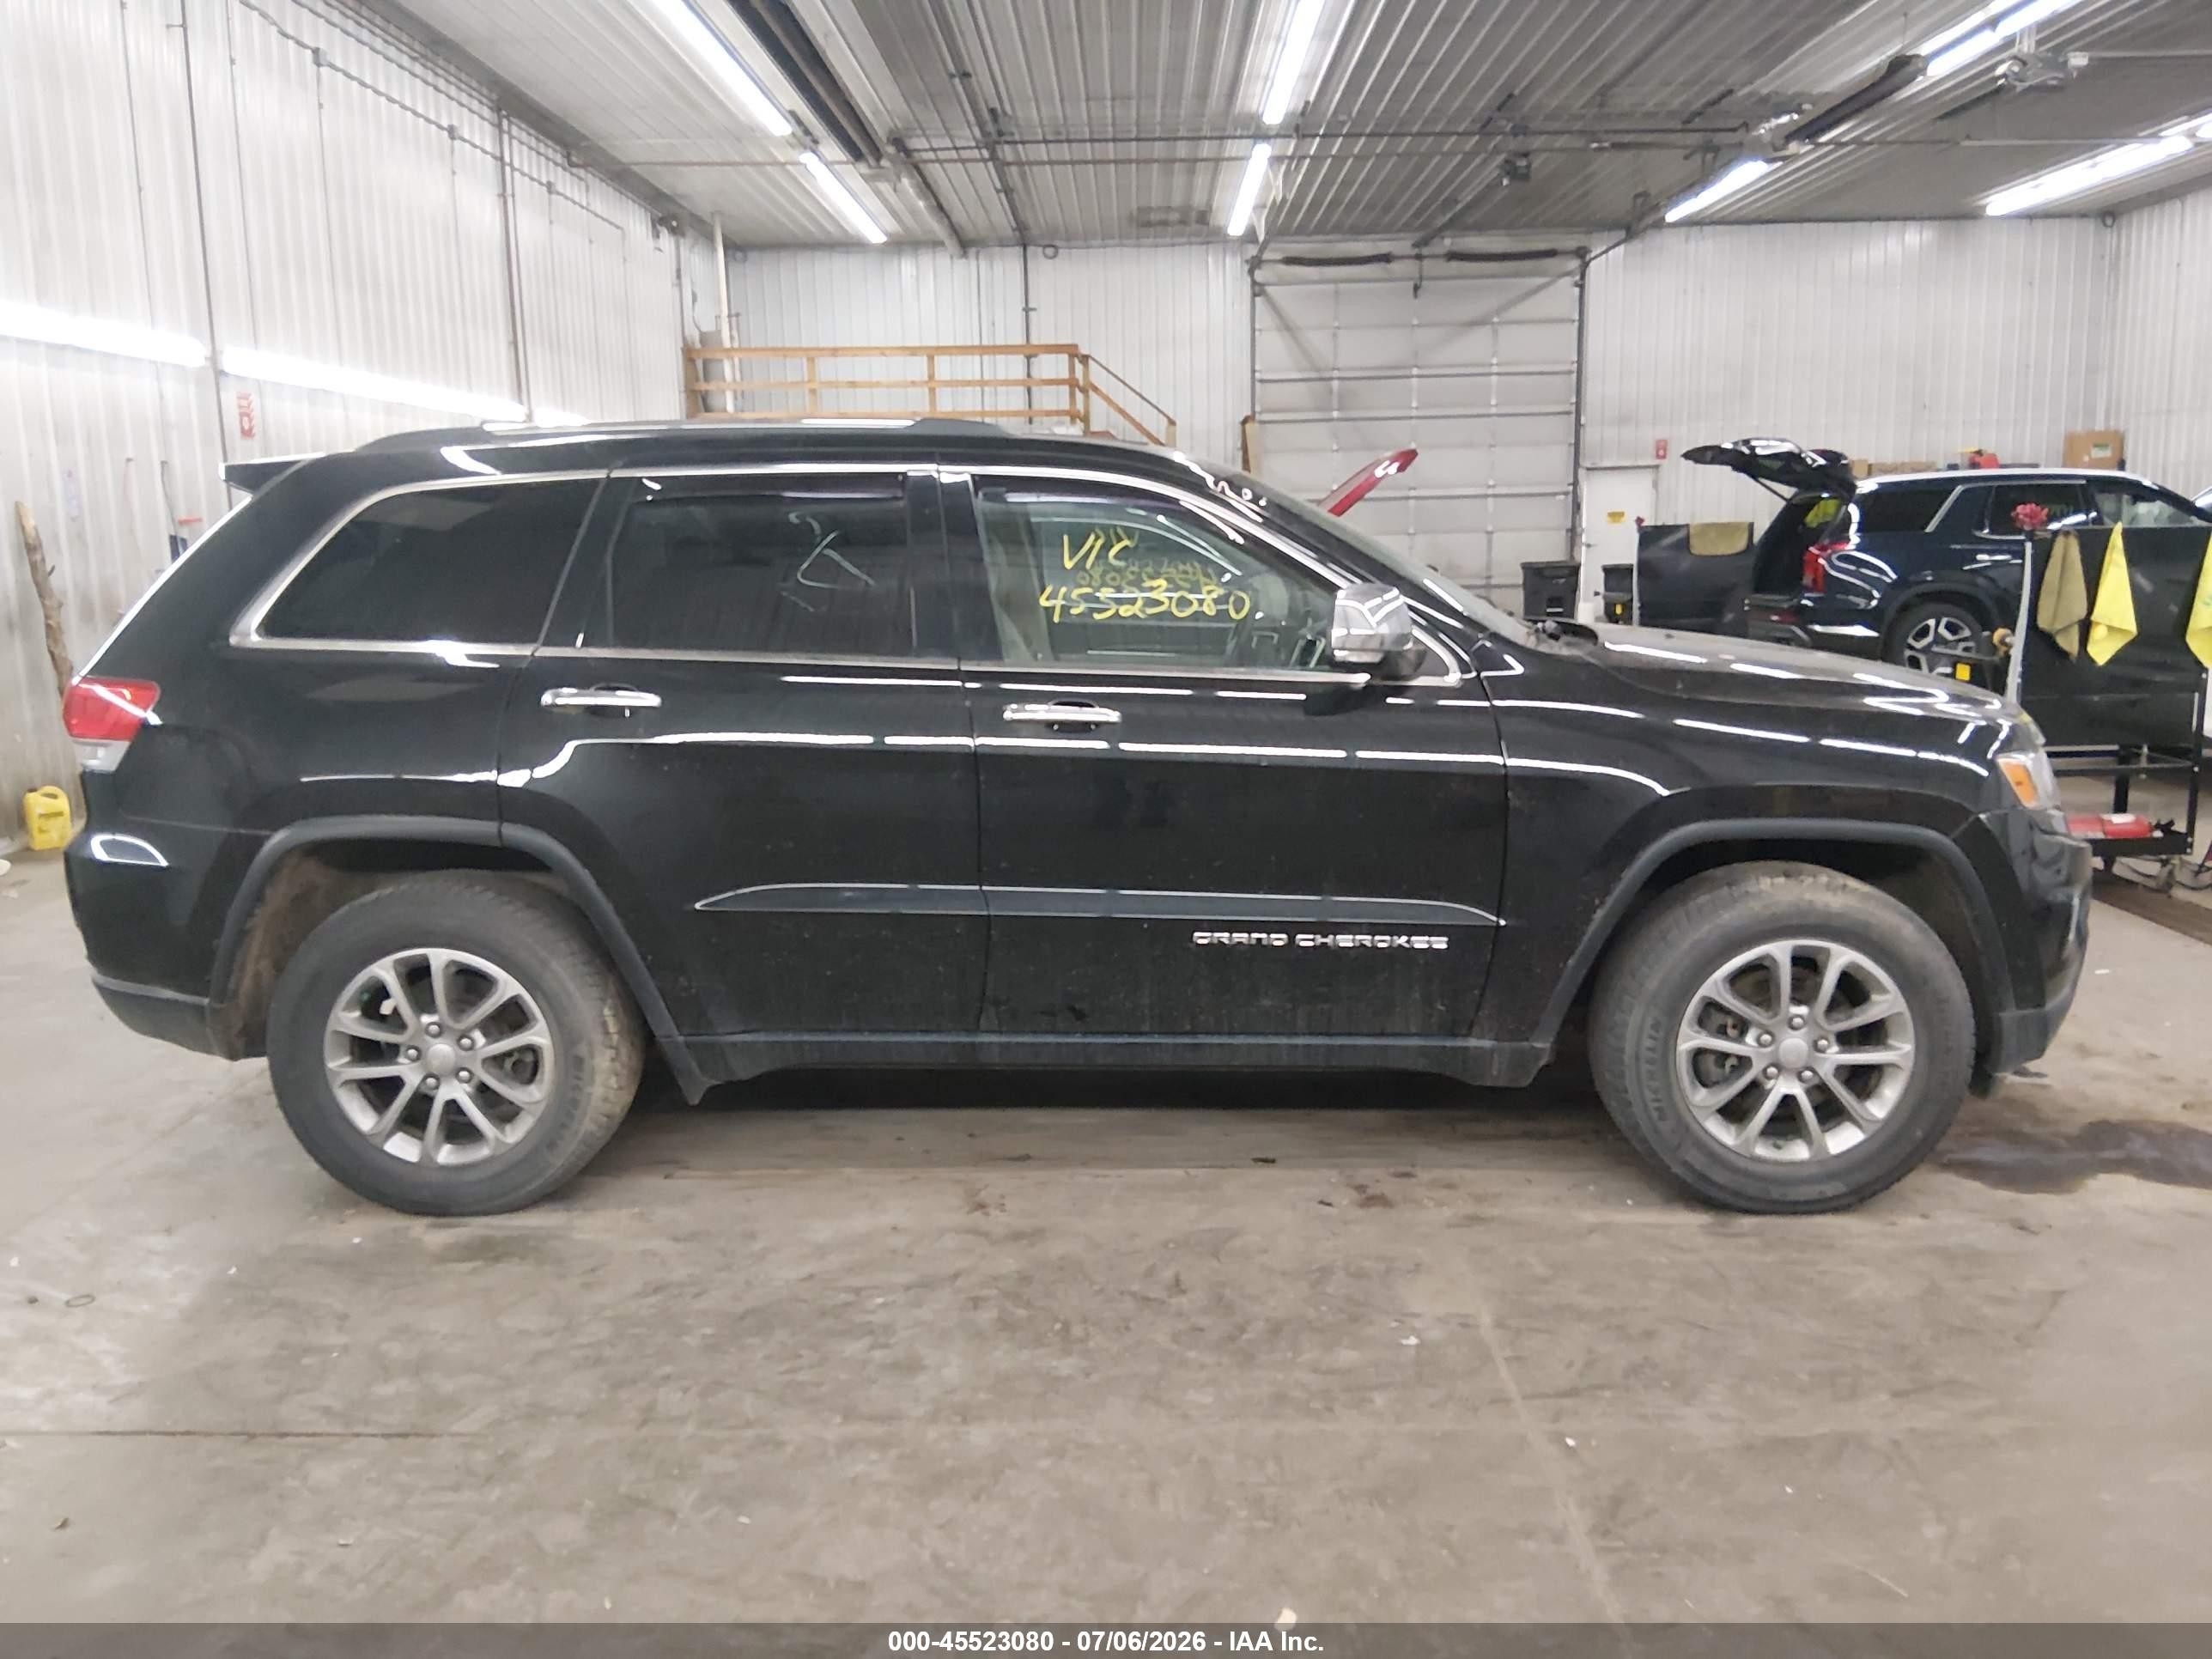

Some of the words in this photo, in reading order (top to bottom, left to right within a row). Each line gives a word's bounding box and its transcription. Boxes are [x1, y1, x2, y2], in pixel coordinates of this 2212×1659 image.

[1039, 579, 1250, 623] 45523080
[1193, 932, 1287, 946] GRAND
[1295, 933, 1449, 949] CHEROKEE
